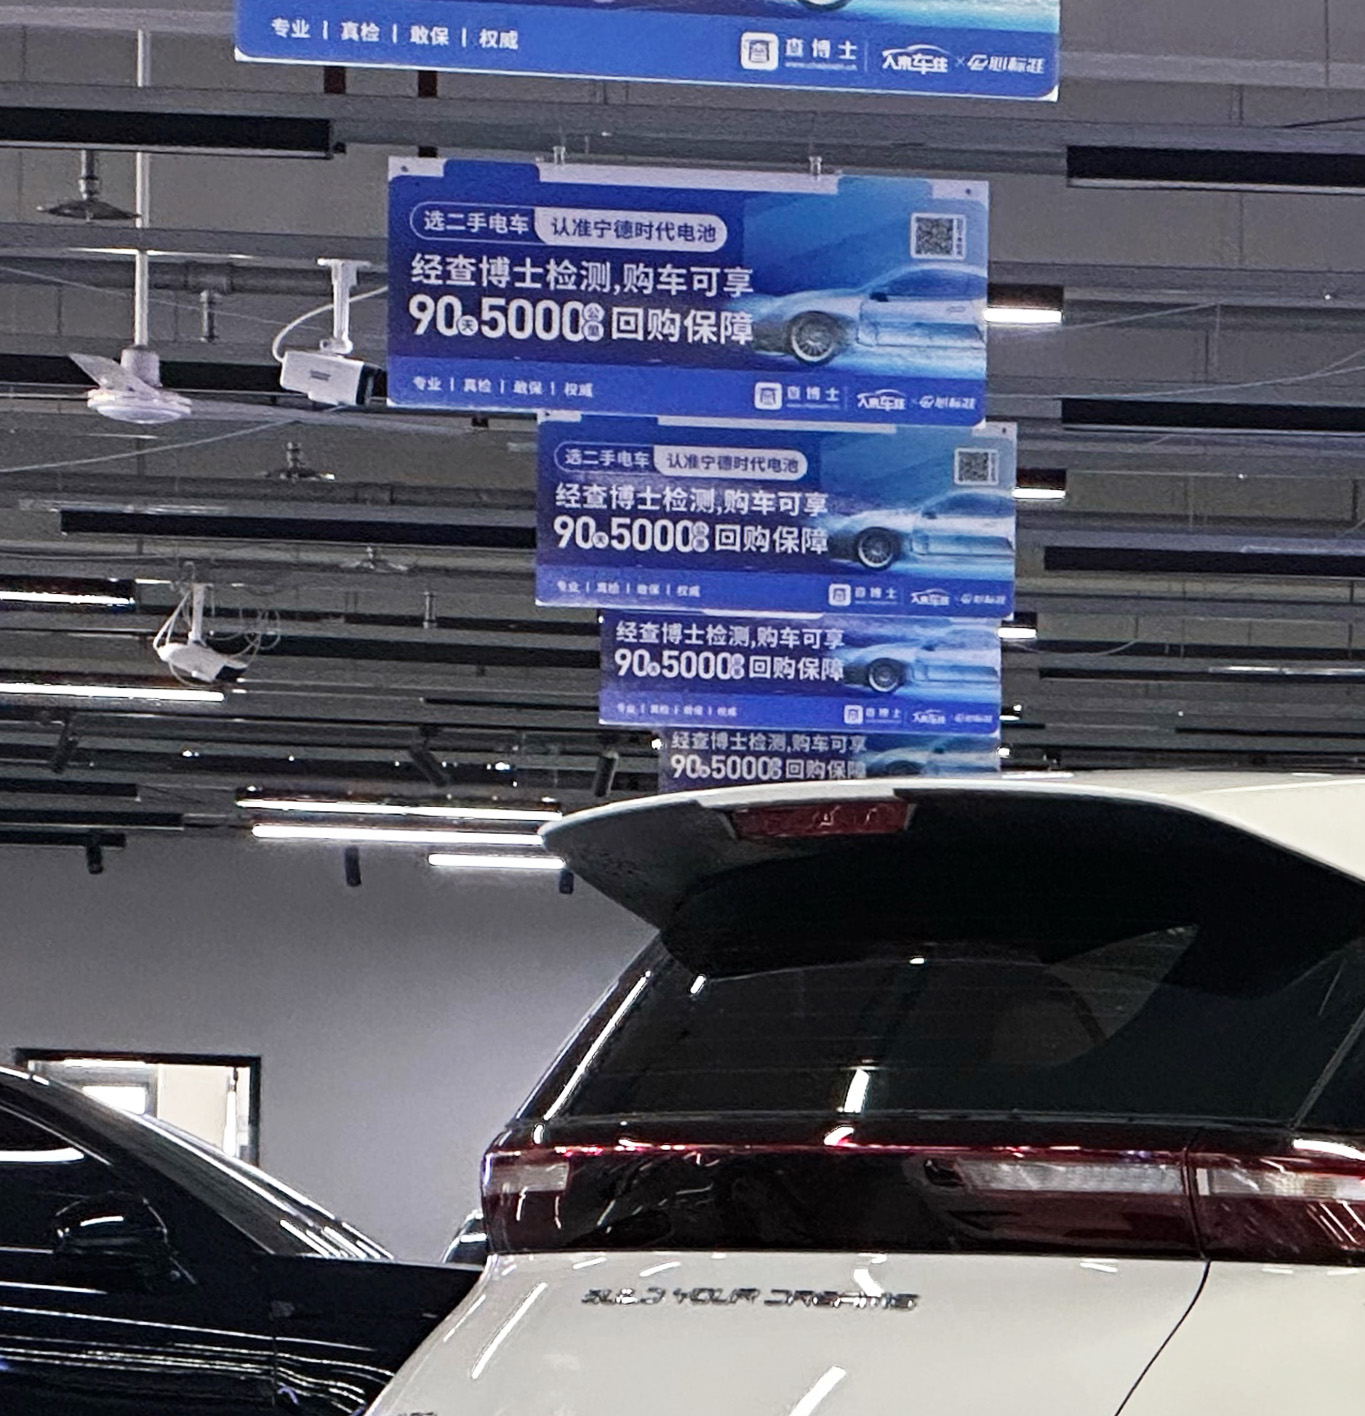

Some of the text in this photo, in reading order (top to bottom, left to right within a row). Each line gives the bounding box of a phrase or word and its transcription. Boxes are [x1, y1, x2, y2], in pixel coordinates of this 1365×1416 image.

[270, 18, 518, 50] 专业 真检 敢保 权威
[424, 210, 529, 235] 选二手电车
[551, 217, 717, 243] 认准宁德时代电池
[411, 252, 754, 298] 经查博士检测,购车可享
[611, 306, 753, 346] 回购保障
[565, 449, 650, 468] 选二手电车
[667, 452, 799, 474] 认准宁德时代电池
[555, 482, 829, 517] 经查博士检测,购车可享
[714, 523, 829, 555] 回购保障
[615, 620, 845, 650] 经查博士检测,购车可享
[749, 656, 845, 682] 回购保障
[671, 731, 867, 754] 经查博士检测,购车可享
